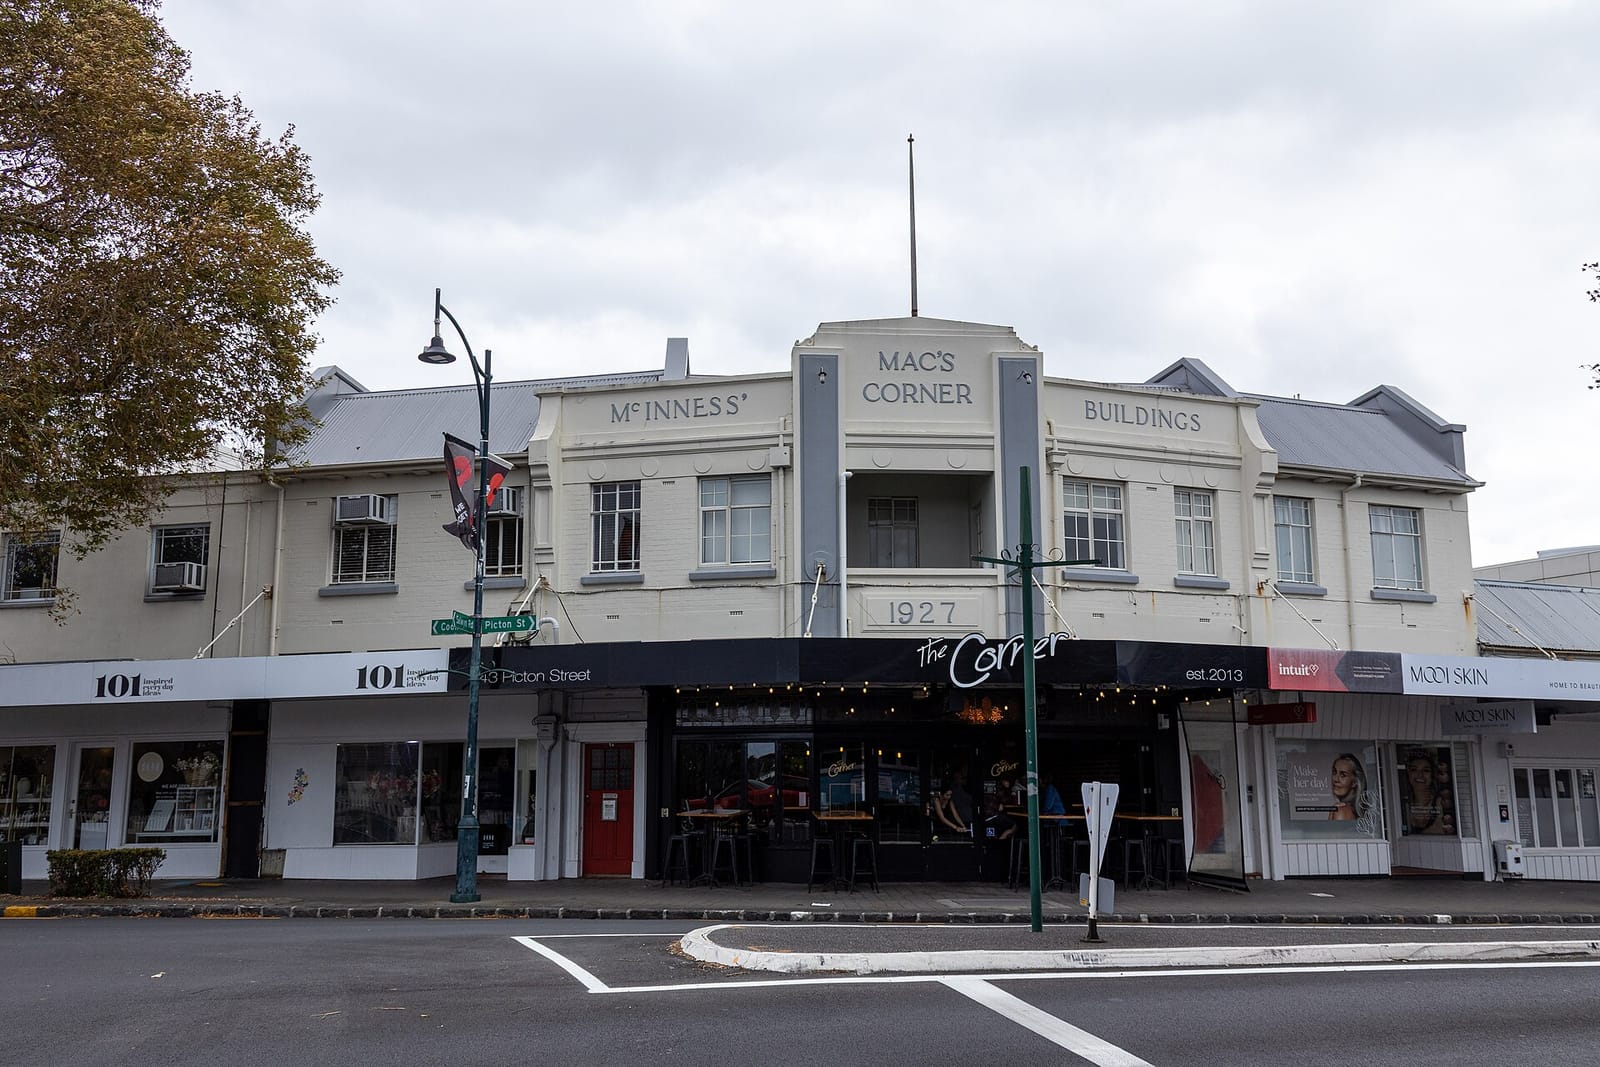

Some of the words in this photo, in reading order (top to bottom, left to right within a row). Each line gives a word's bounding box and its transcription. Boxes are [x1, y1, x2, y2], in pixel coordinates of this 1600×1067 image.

[879, 351, 955, 372] MAC'S
[862, 383, 972, 404] CORNER
[1084, 400, 1201, 431] BUILDINGS
[889, 601, 956, 624] 1927
[485, 620, 512, 629] Picton
[516, 618, 525, 627] St
[916, 637, 949, 668] The
[355, 664, 405, 689] 101
[502, 670, 545, 683] Picton
[549, 668, 591, 682] Street
[1186, 668, 1243, 682] est.2013
[1279, 663, 1310, 676] intuit
[1410, 666, 1450, 684] MOOI
[1454, 667, 1488, 685] SKIN
[95, 673, 141, 698] 101
[143, 677, 173, 685] inspired
[1455, 711, 1485, 723] MOOI
[1487, 708, 1516, 722] SKIN
[828, 763, 856, 777] Corner
[991, 762, 1019, 777] Corner
[1293, 764, 1319, 777] Make
[1293, 776, 1310, 788] her
[1310, 777, 1329, 791] day!
